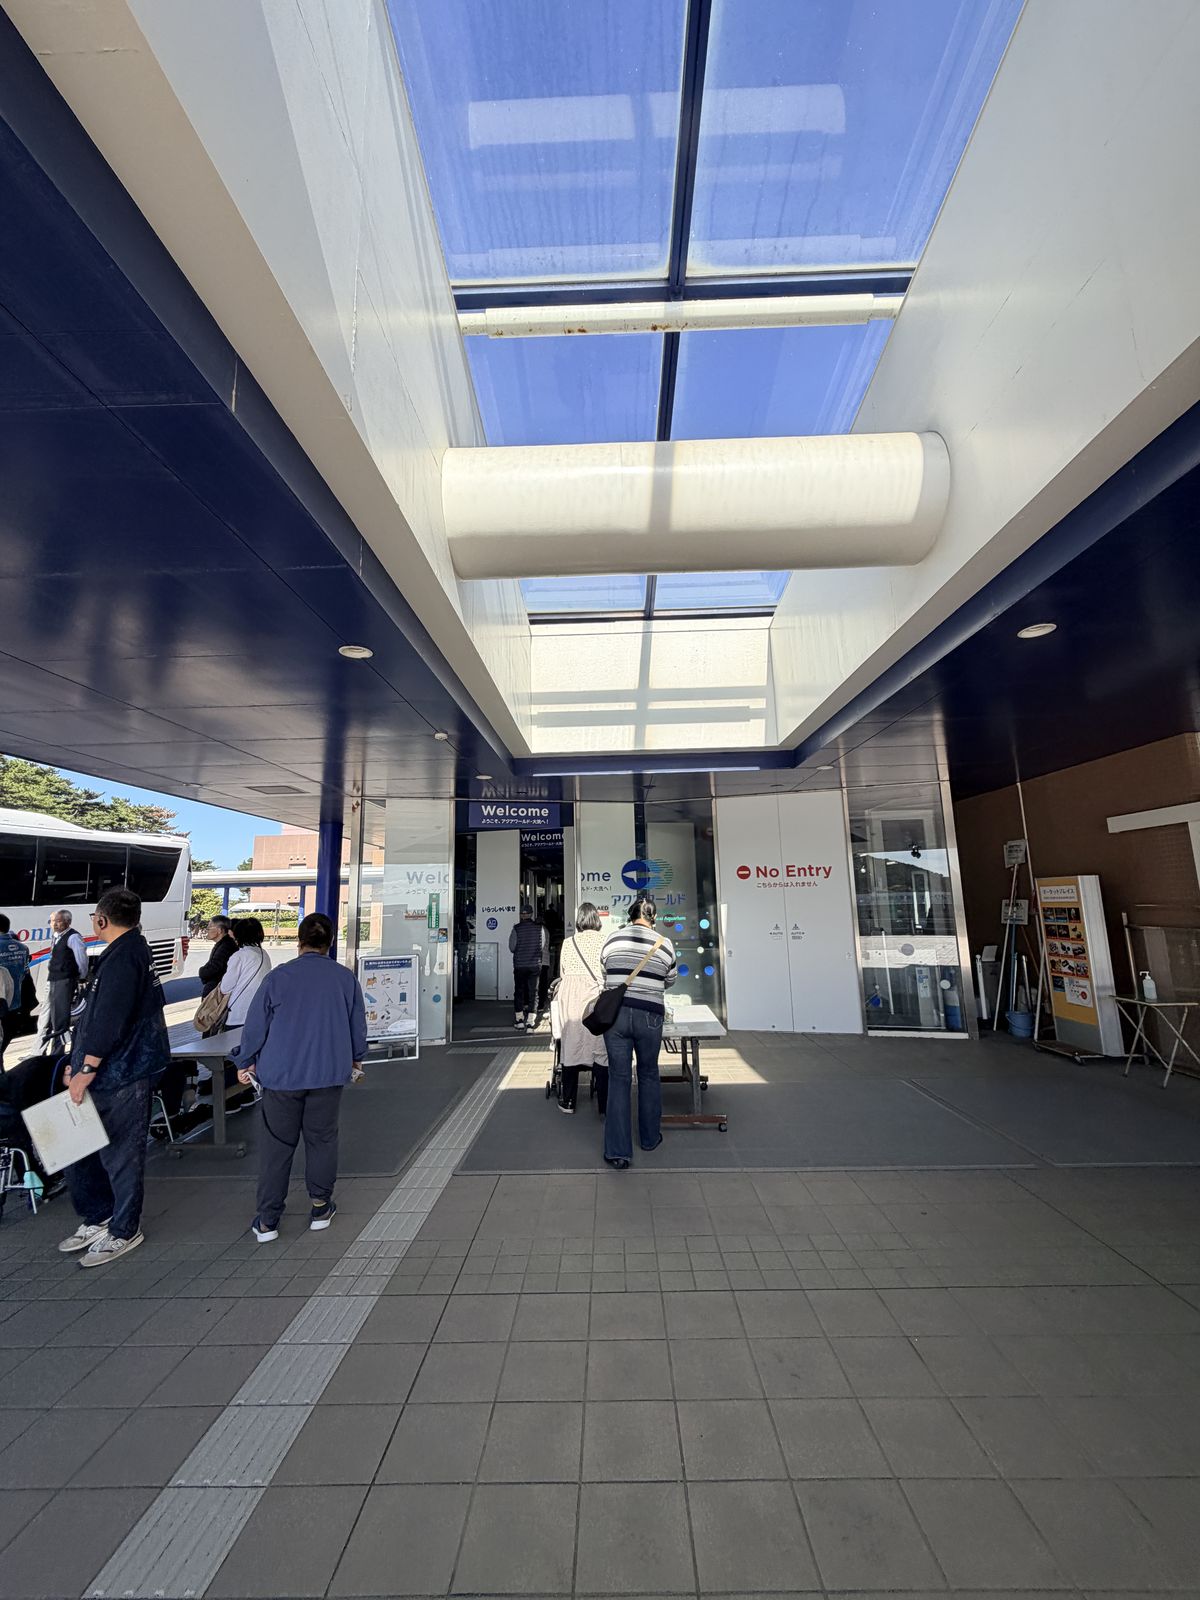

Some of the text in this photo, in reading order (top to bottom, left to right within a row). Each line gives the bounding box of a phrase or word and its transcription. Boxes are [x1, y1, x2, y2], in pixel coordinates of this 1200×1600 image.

[481, 805, 549, 817] Welcome
[756, 865, 832, 878] No Entry
